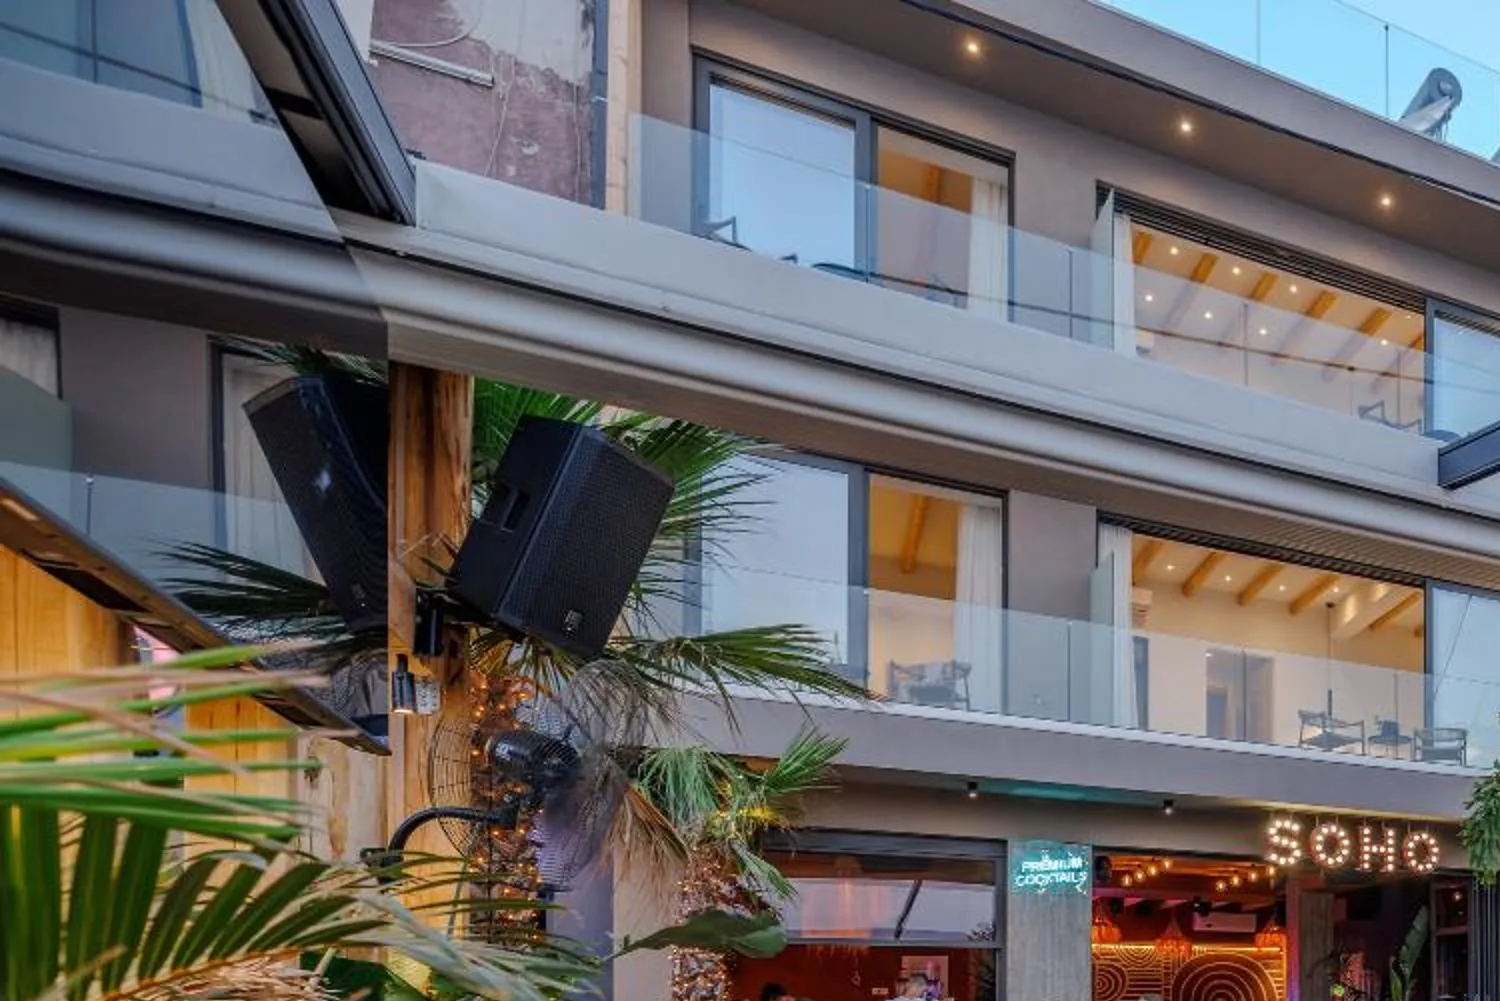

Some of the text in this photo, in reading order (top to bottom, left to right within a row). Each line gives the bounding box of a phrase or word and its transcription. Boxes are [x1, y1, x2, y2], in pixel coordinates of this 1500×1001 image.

[1264, 817, 1440, 875] SOHO
[1021, 856, 1083, 872] PREMIUM
[1015, 871, 1088, 887] COCKTAILS
